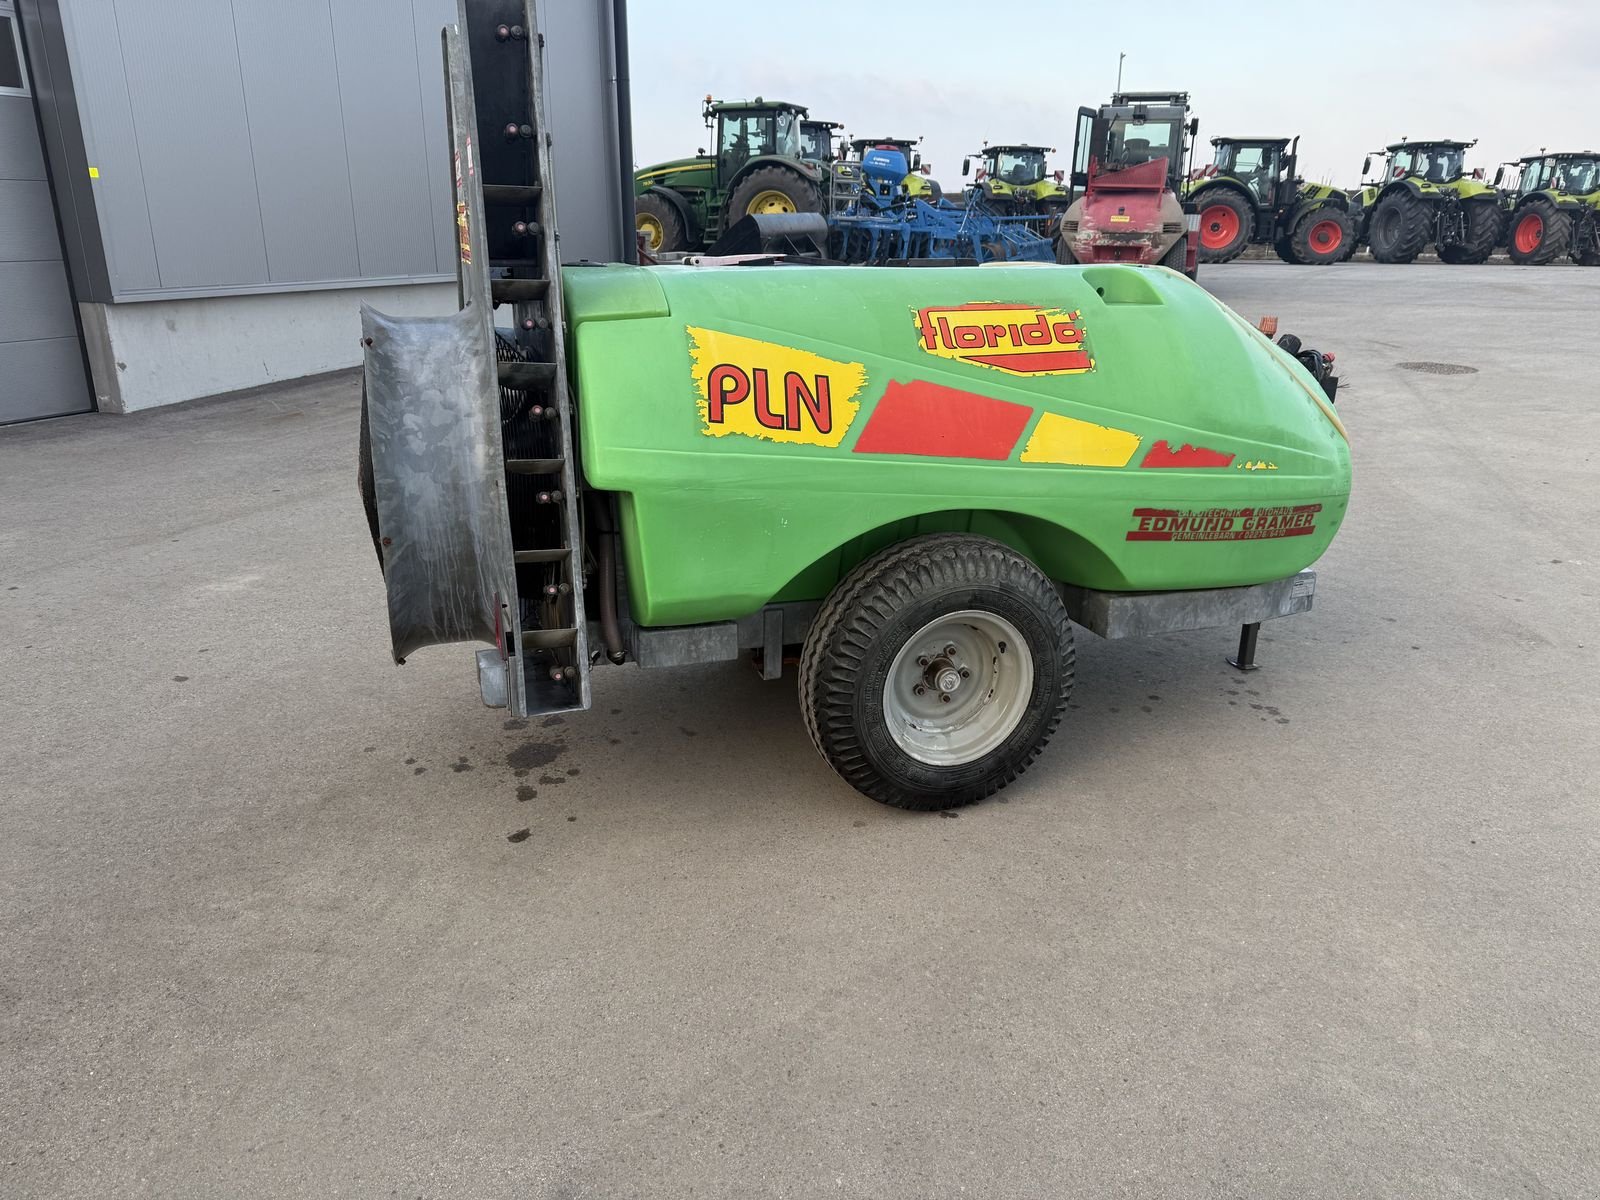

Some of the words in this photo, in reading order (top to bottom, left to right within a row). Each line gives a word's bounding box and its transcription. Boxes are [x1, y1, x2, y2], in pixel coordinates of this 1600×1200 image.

[707, 363, 833, 434] PLN
[1138, 516, 1234, 532] EDMUND
[1242, 513, 1315, 531] GRAMER
